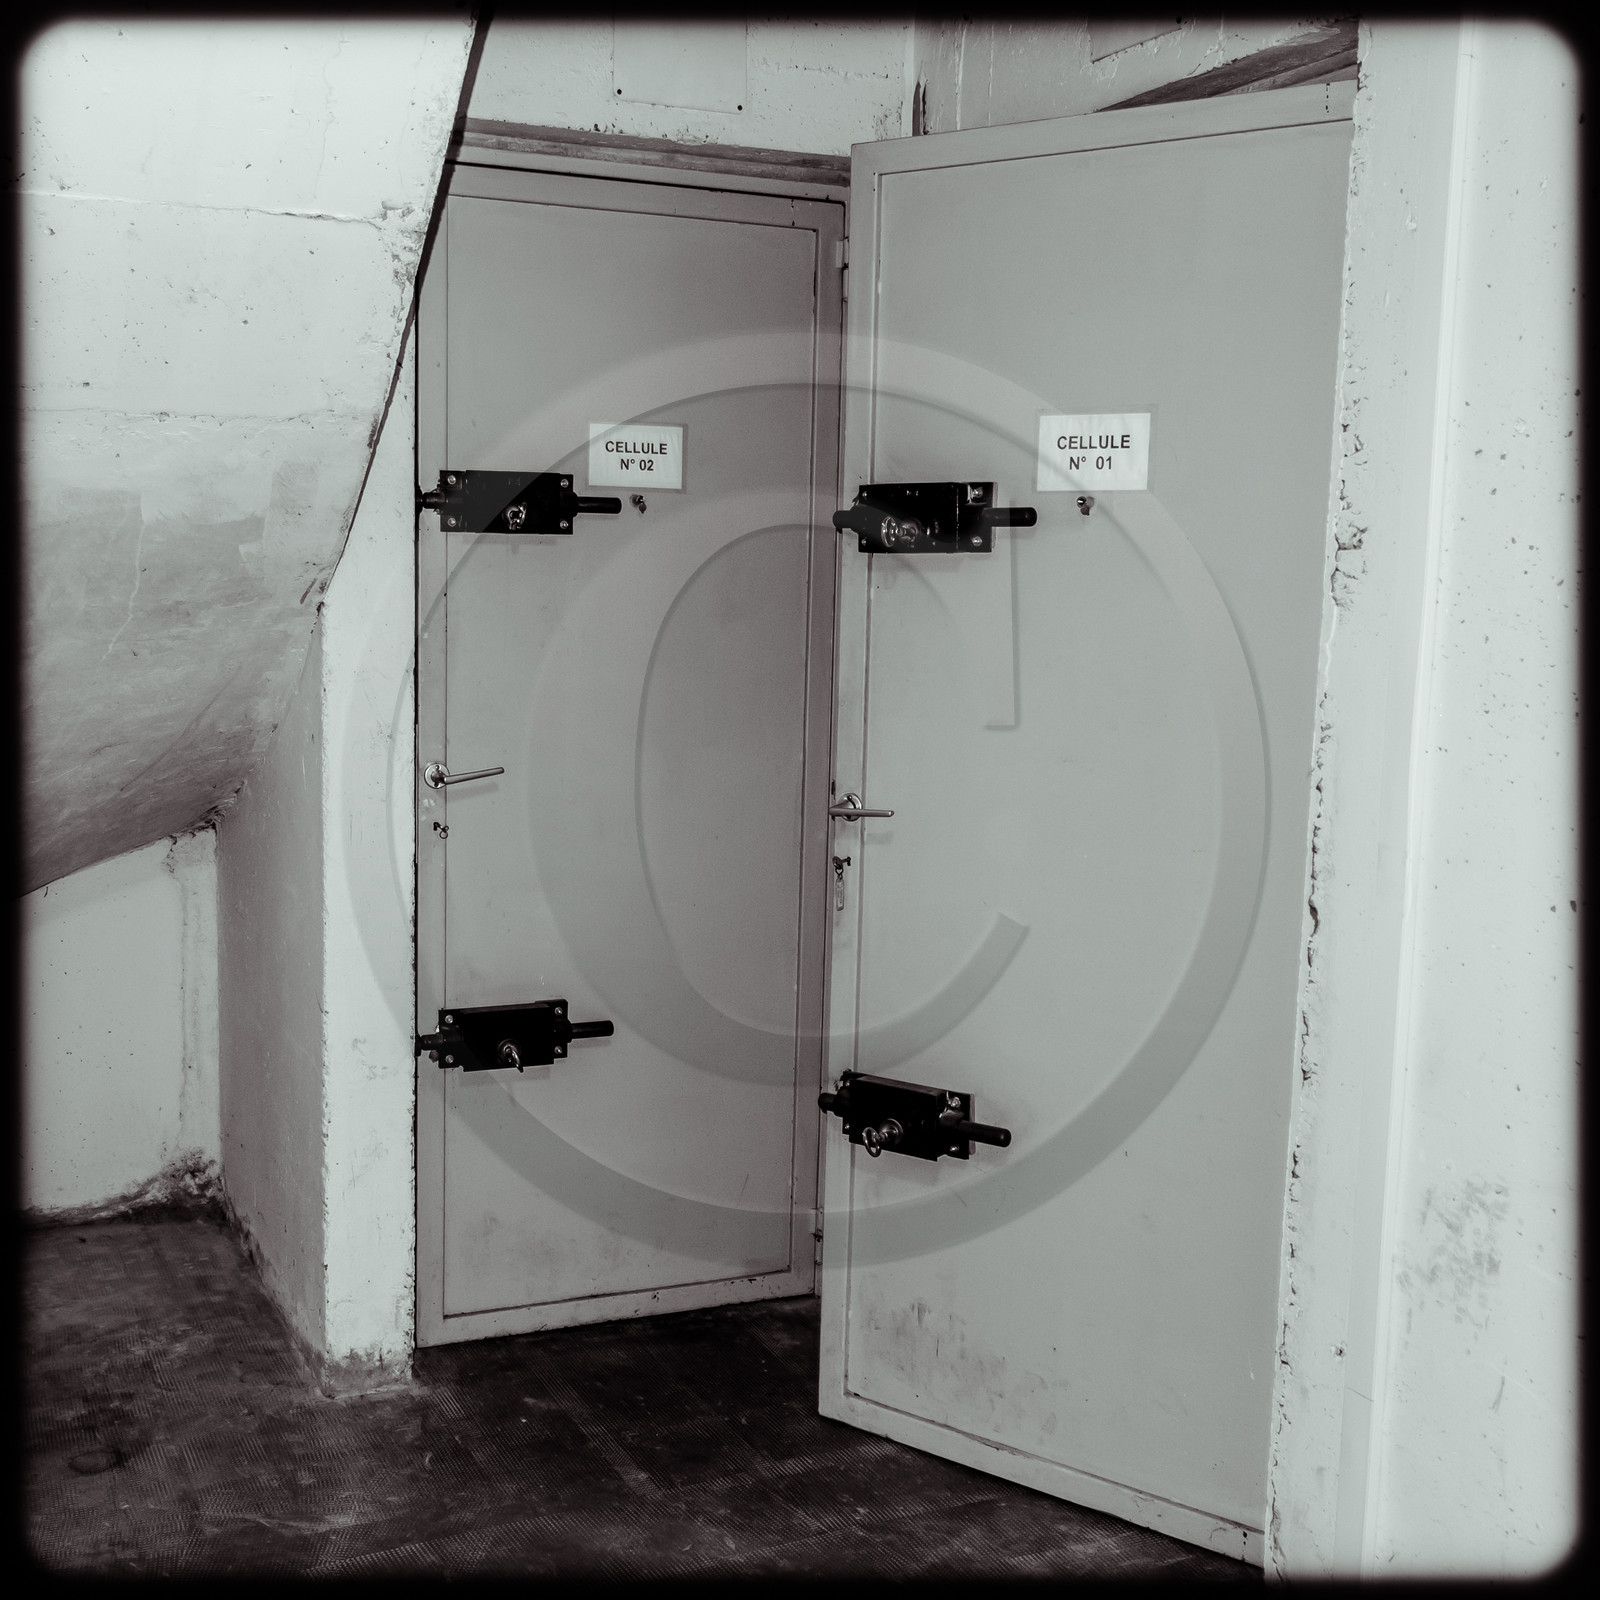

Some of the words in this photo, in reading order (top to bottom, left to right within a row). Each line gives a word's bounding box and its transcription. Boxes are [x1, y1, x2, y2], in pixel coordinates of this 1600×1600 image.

[605, 440, 668, 455] CELLULE
[1057, 434, 1131, 450] CELLULE
[620, 458, 636, 471] N°
[639, 459, 654, 472] 02
[1069, 456, 1087, 470] N°
[1095, 455, 1112, 470] 01
